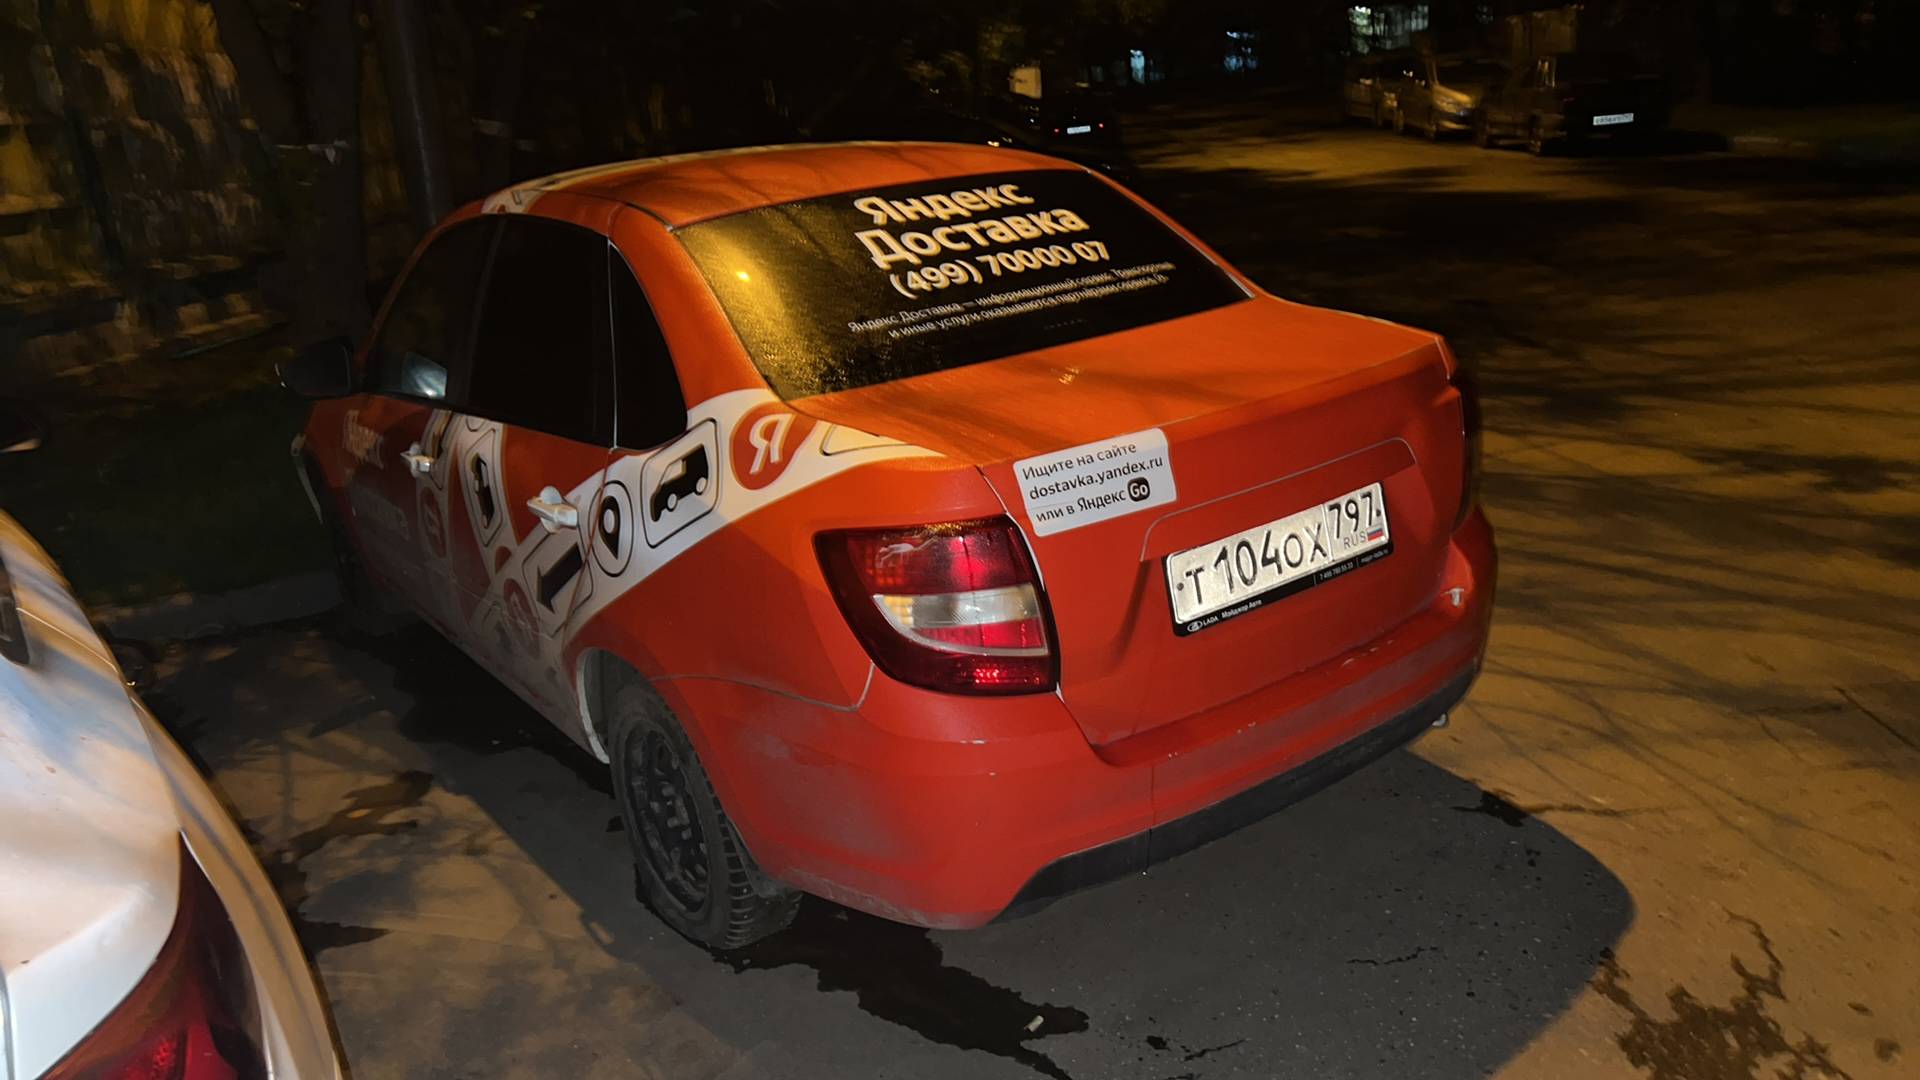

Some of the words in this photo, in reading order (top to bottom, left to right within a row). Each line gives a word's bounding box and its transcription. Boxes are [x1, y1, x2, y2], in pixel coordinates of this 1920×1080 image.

[854, 184, 1034, 225] Яндекс
[854, 208, 1090, 270] Доставка
[889, 259, 983, 299] (499)
[975, 244, 1077, 276] 70000
[1071, 241, 1110, 262] 07
[848, 315, 899, 333] Яндекс
[899, 302, 964, 323] Доставка
[975, 278, 1078, 306] информационный
[888, 329, 900, 339] и
[900, 322, 936, 338] иные
[935, 312, 981, 330] услуги
[980, 297, 1058, 321] оказываются
[1022, 458, 1073, 480] Ищите
[1077, 454, 1095, 467] на
[1097, 443, 1137, 461] сайте
[1029, 456, 1164, 500] dostavka.yandex.ru
[1036, 507, 1064, 522] или
[1066, 504, 1076, 515] в
[1077, 489, 1127, 512] Яндекс
[1129, 482, 1150, 498] Go
[1328, 491, 1374, 539] 797
[1343, 531, 1367, 550] RUS
[1203, 615, 1219, 626] LADA
